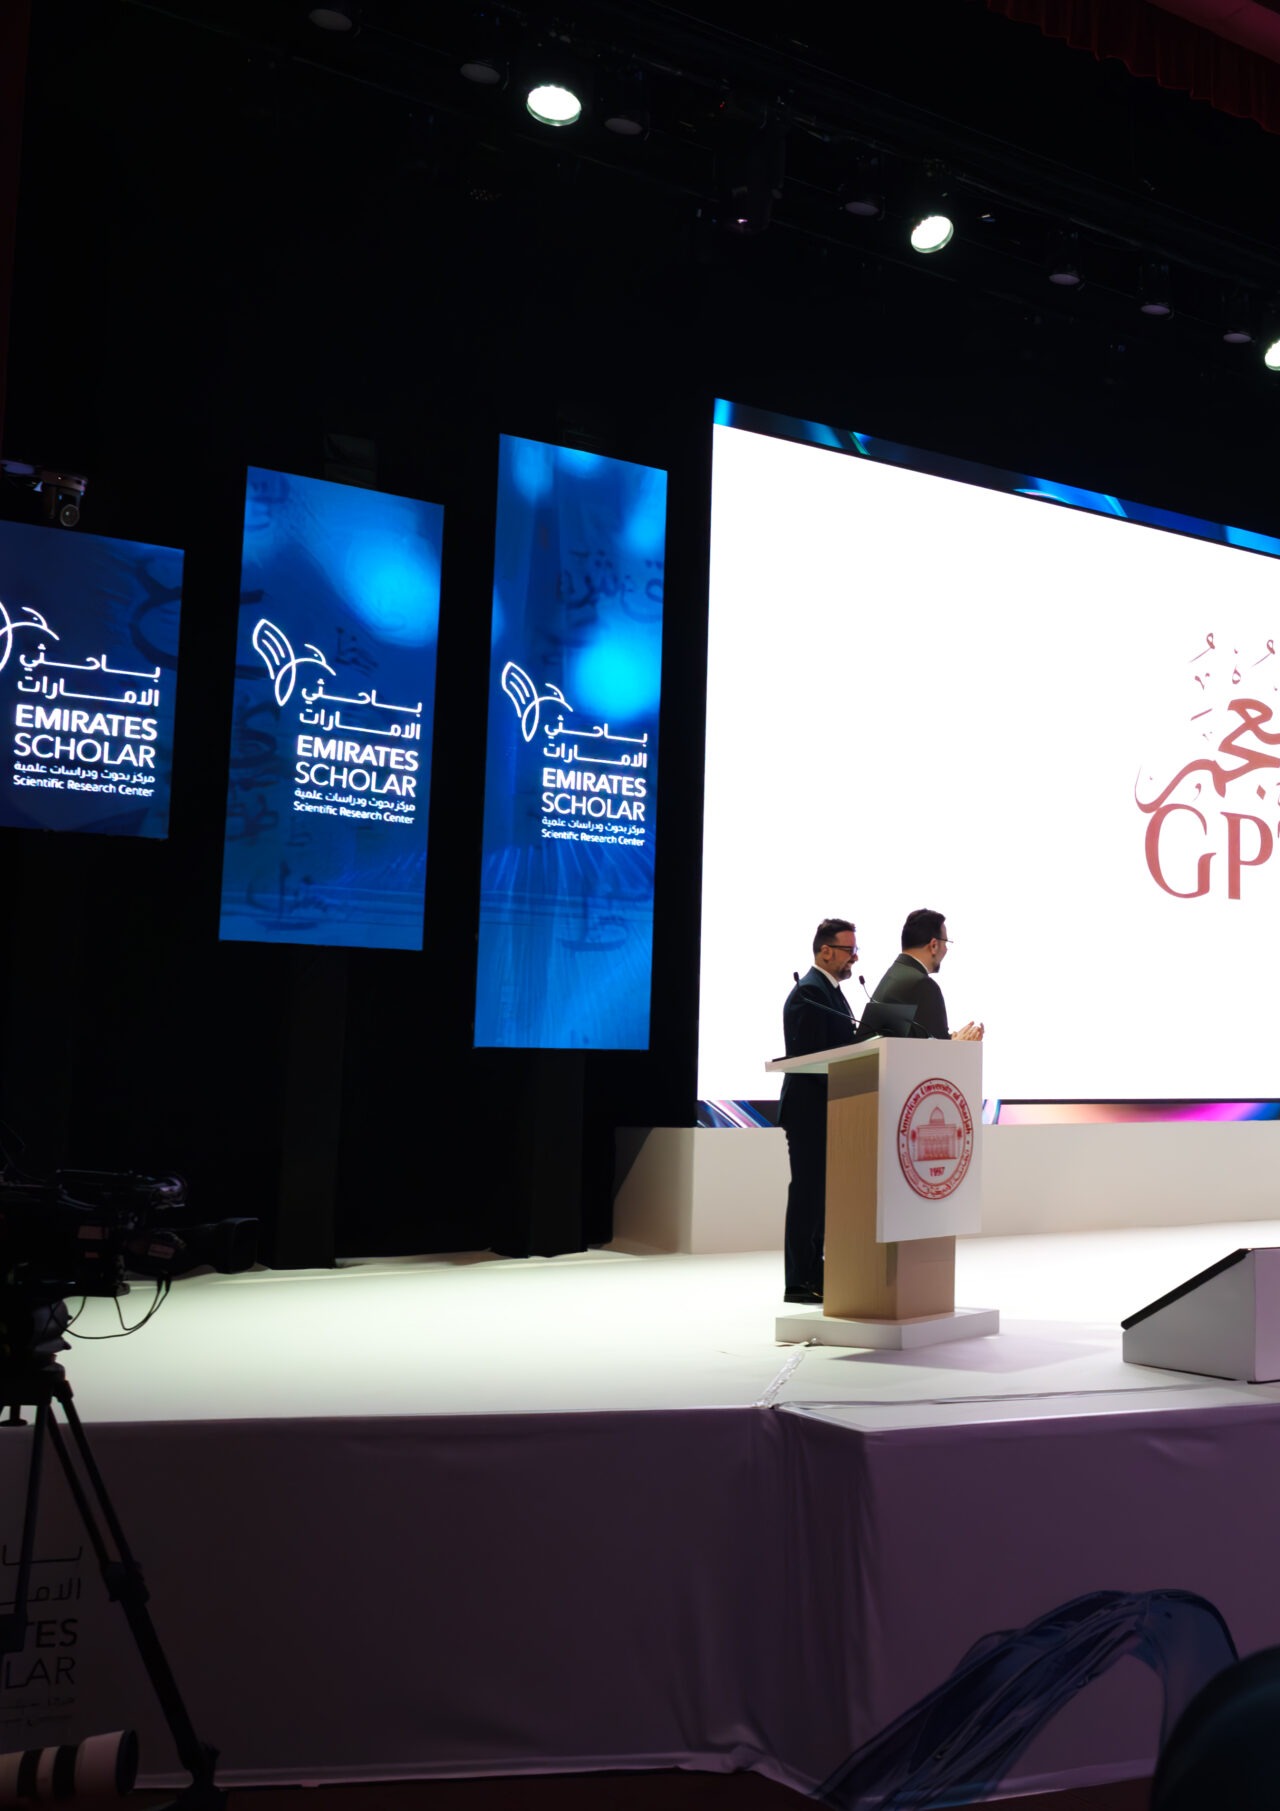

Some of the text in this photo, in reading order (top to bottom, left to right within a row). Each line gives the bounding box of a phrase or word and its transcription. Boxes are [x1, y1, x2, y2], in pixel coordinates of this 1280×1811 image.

[15, 704, 158, 740] EMIRATES
[14, 732, 156, 768] SCHOLAR
[296, 734, 418, 771] EMIRATES
[13, 774, 154, 797] Scientific Research Center
[294, 762, 417, 797] SCHOLAR
[542, 767, 646, 798] EMIRATES
[293, 800, 415, 824] Scientific Research Center
[542, 792, 645, 821] SCHOLAR
[541, 828, 645, 846] Scientific Research Center
